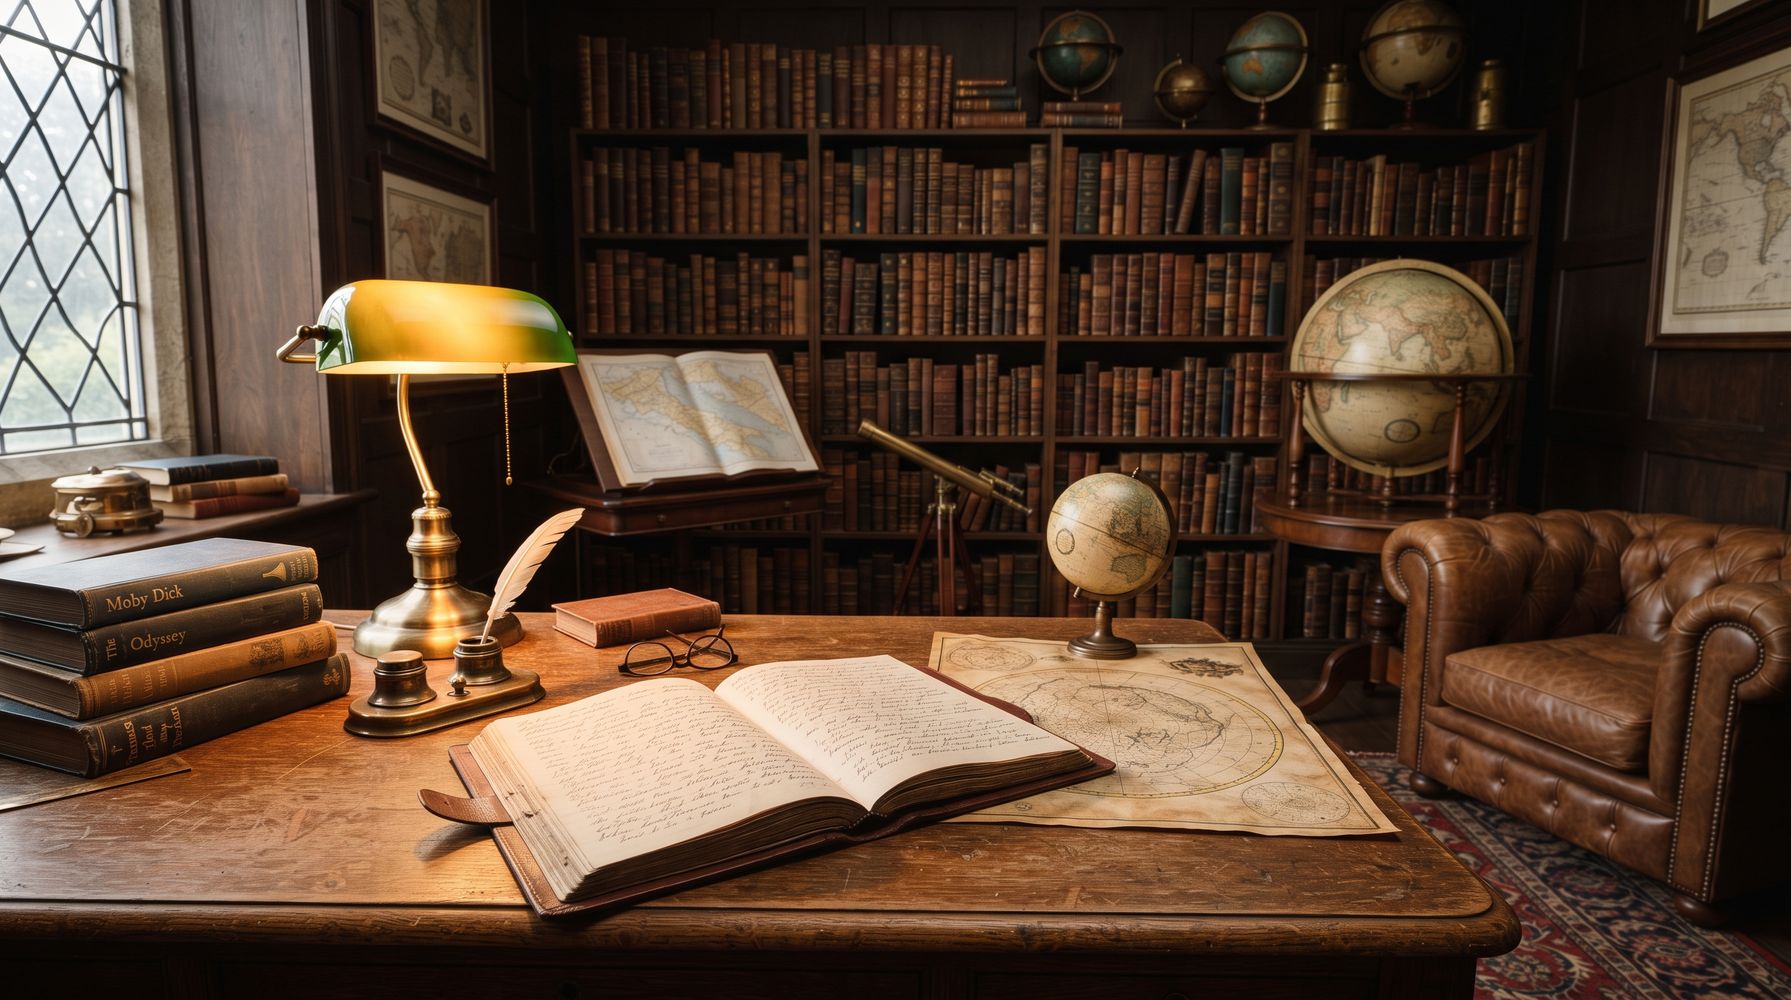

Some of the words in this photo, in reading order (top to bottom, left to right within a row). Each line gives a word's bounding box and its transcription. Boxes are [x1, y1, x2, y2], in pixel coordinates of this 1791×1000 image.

[105, 593, 148, 613] Moby
[152, 584, 184, 603] Dick
[105, 638, 118, 661] The
[130, 630, 186, 652] Odyssey
